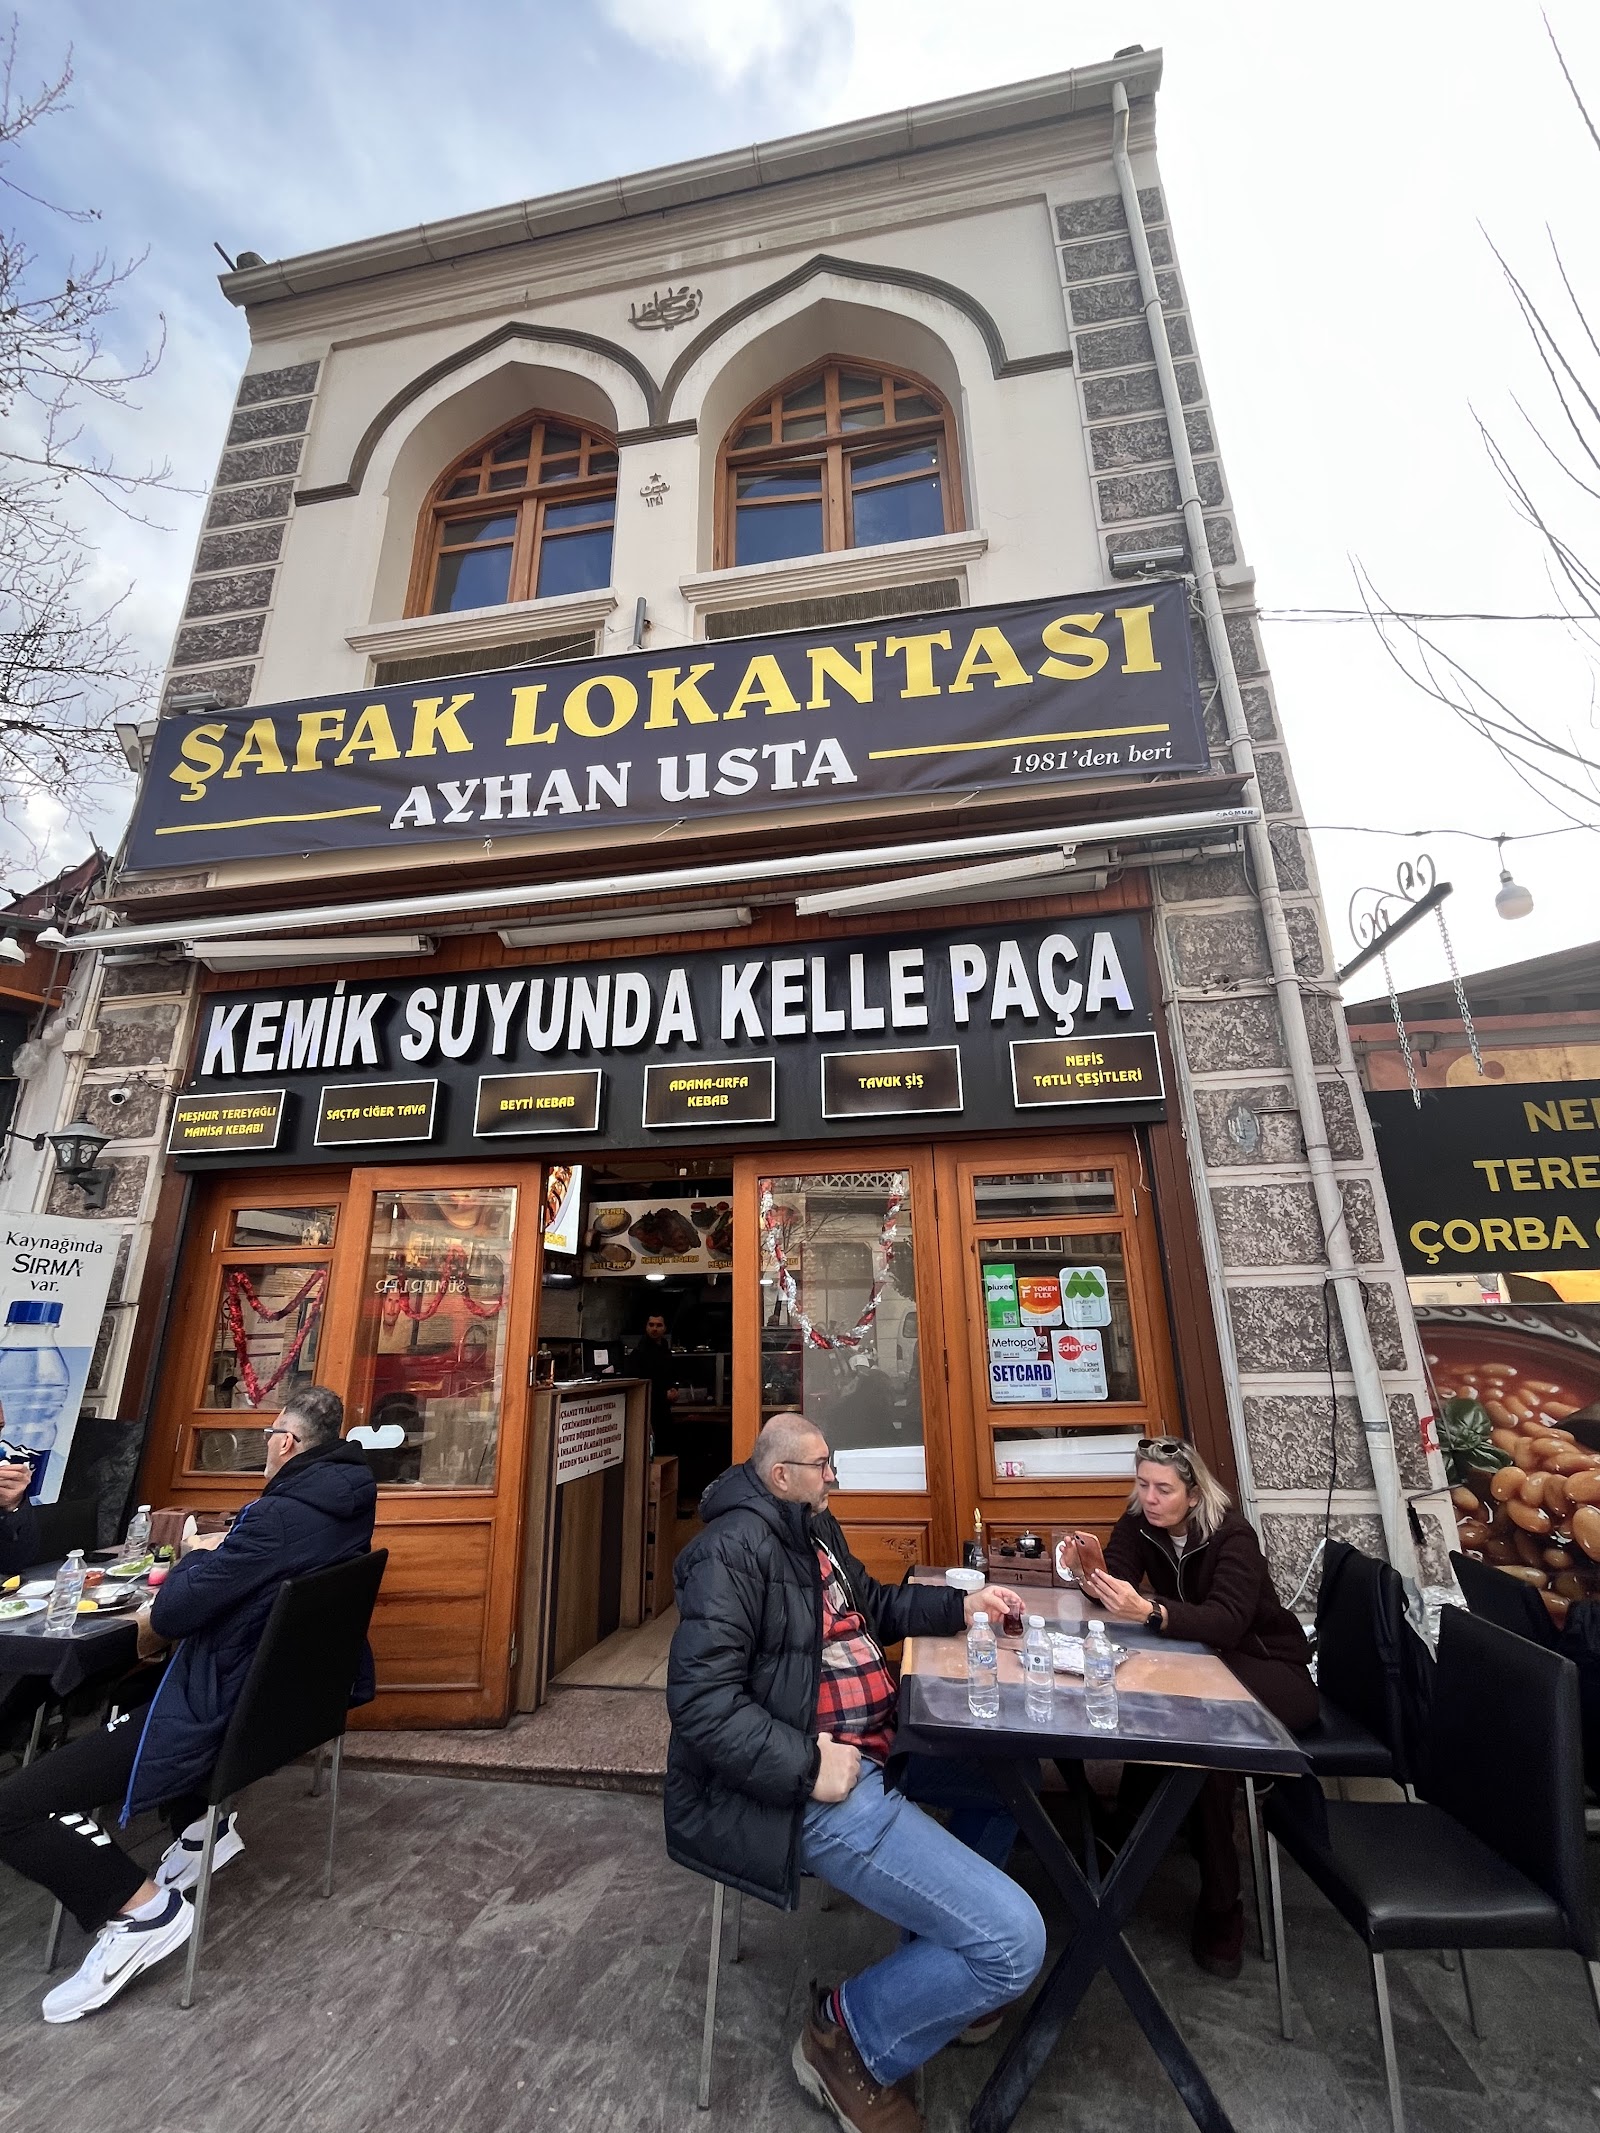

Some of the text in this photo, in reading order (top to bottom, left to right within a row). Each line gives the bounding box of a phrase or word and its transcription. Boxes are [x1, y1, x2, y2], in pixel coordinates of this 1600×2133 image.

[169, 604, 1162, 802] ŞAFAK LOKANTASI
[1127, 741, 1173, 763] beri
[390, 761, 632, 830] AYHAN
[201, 931, 1134, 1075] KEMİK SUYUNDA KELLE PAÇA
[1065, 1052, 1104, 1067] NEFİS
[669, 1075, 749, 1092] ADANA-URFA
[858, 1072, 925, 1090] TAVUK ŞİŞ
[1032, 1067, 1143, 1088] TATLI ÇEŞİTLERİ
[499, 1095, 576, 1112] BEYTİ KEBAB
[687, 1094, 729, 1107] KEBAB
[178, 1106, 277, 1125] MEŞHUR TEREYAĞLI
[326, 1103, 427, 1122] SAÇTA CİĞER TAVA
[184, 1122, 264, 1138] MANİSA KEBABI
[1472, 1155, 1600, 1192] TERE
[6, 1230, 104, 1255] Kaynağında
[1409, 1215, 1590, 1265] ÇORBA
[12, 1253, 83, 1278] SIRMA
[30, 1278, 60, 1293] var.
[987, 1284, 1013, 1292] pluxee
[991, 1337, 1036, 1349] Metropol
[1058, 1342, 1098, 1352] Edenred
[992, 1363, 1052, 1382] SETCARD
